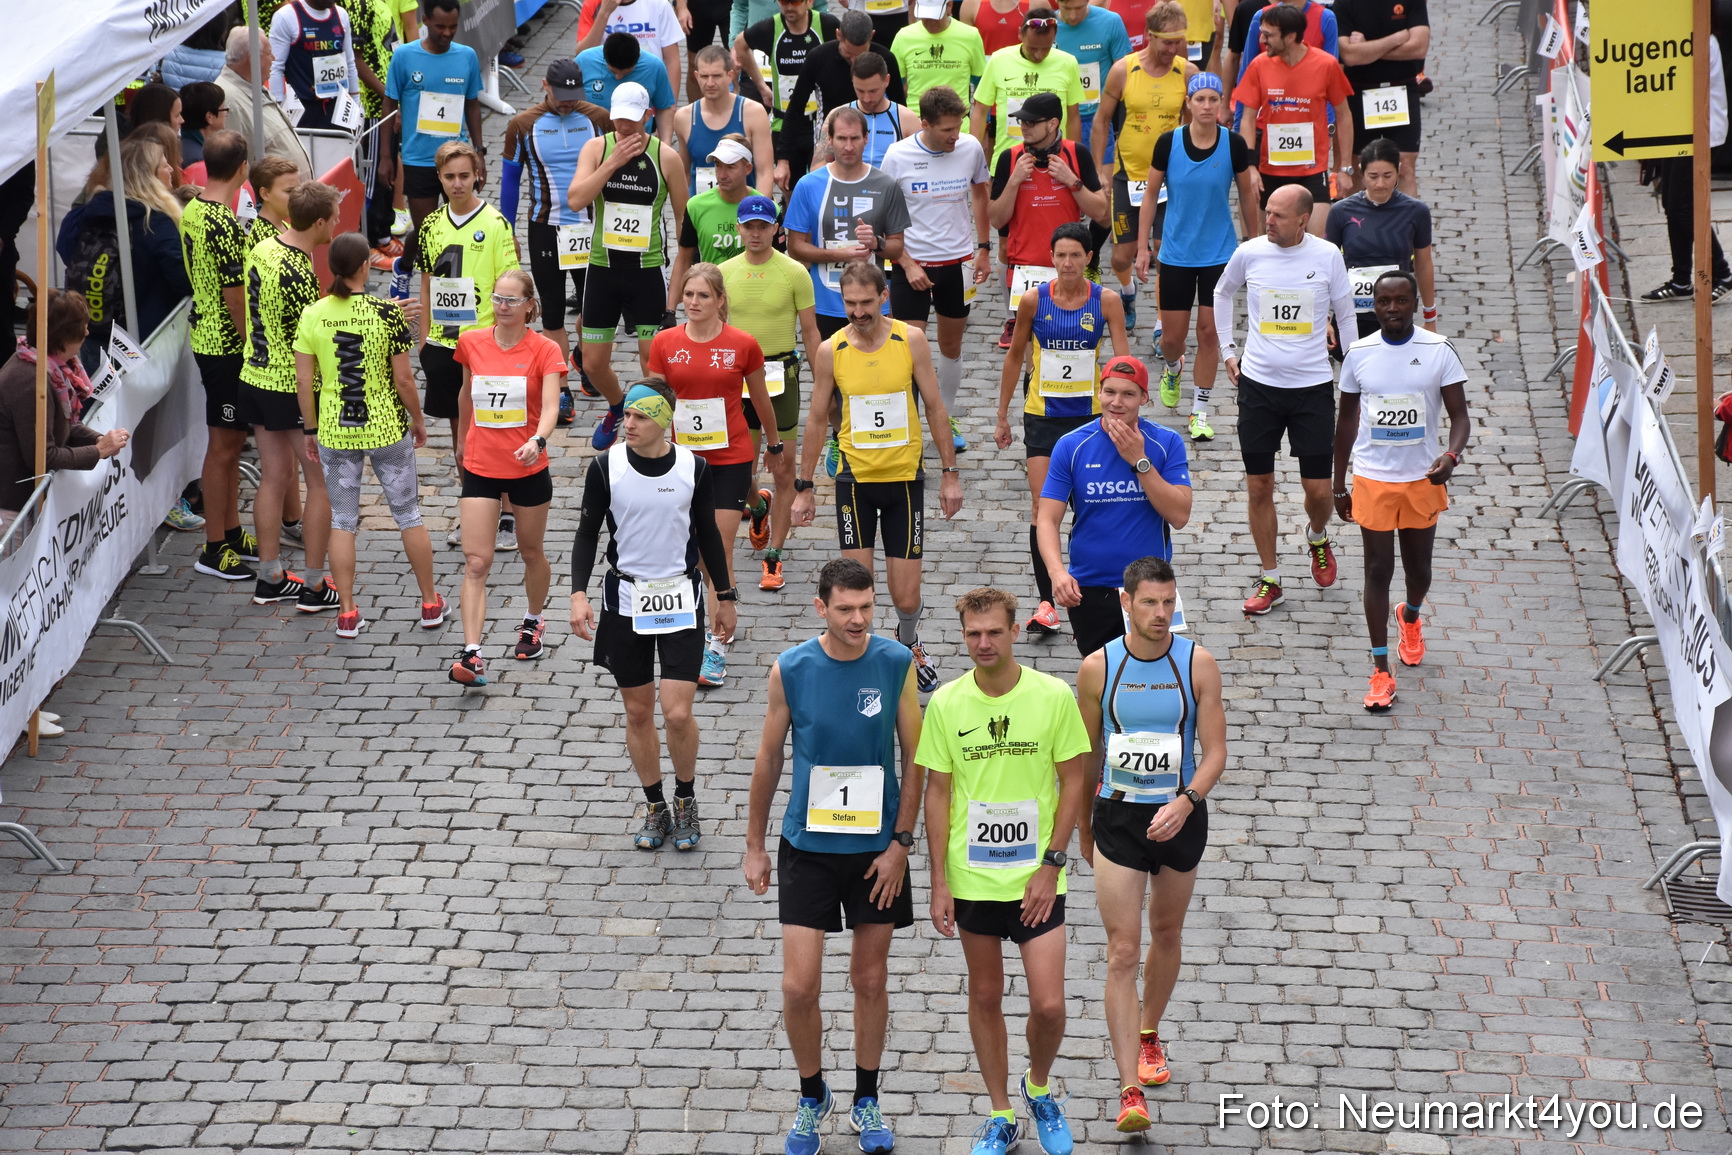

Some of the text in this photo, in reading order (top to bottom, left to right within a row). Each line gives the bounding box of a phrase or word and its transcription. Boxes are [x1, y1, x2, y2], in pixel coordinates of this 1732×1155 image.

[303, 40, 343, 51] MENSC
[1595, 32, 1694, 68] Jugend
[320, 66, 345, 82] 2645
[1626, 66, 1676, 93] lauf
[341, 101, 352, 123] swn
[437, 107, 445, 119] 4
[1374, 100, 1397, 113] 143
[1278, 136, 1303, 149] 294
[621, 174, 638, 182] DAV
[606, 181, 652, 192] Röthenbach
[613, 218, 640, 233] 242
[834, 196, 849, 241] ATEC
[713, 234, 742, 248] 201
[86, 253, 108, 322] adidas
[1354, 282, 1374, 296] 29
[436, 292, 467, 307] 2687
[1272, 305, 1301, 320] 187
[321, 318, 348, 328] Team
[351, 317, 374, 326] Partl
[1047, 339, 1088, 350] HEITEC
[1062, 365, 1072, 379] 2
[93, 373, 113, 396] swn
[1653, 367, 1669, 395] swn
[488, 393, 507, 408] 77
[223, 407, 233, 419] 90
[875, 411, 885, 428] 5
[1377, 409, 1417, 426] 2220
[693, 416, 703, 431] 3
[1386, 430, 1409, 438] Zachary
[640, 592, 683, 612] 2001
[655, 617, 674, 625] Stefan
[1118, 751, 1170, 772] 2704
[1133, 776, 1155, 785] Marco
[839, 786, 848, 806] 1
[832, 813, 856, 822] Stefan
[977, 822, 1028, 843] 2000
[989, 849, 1017, 858] Michael
